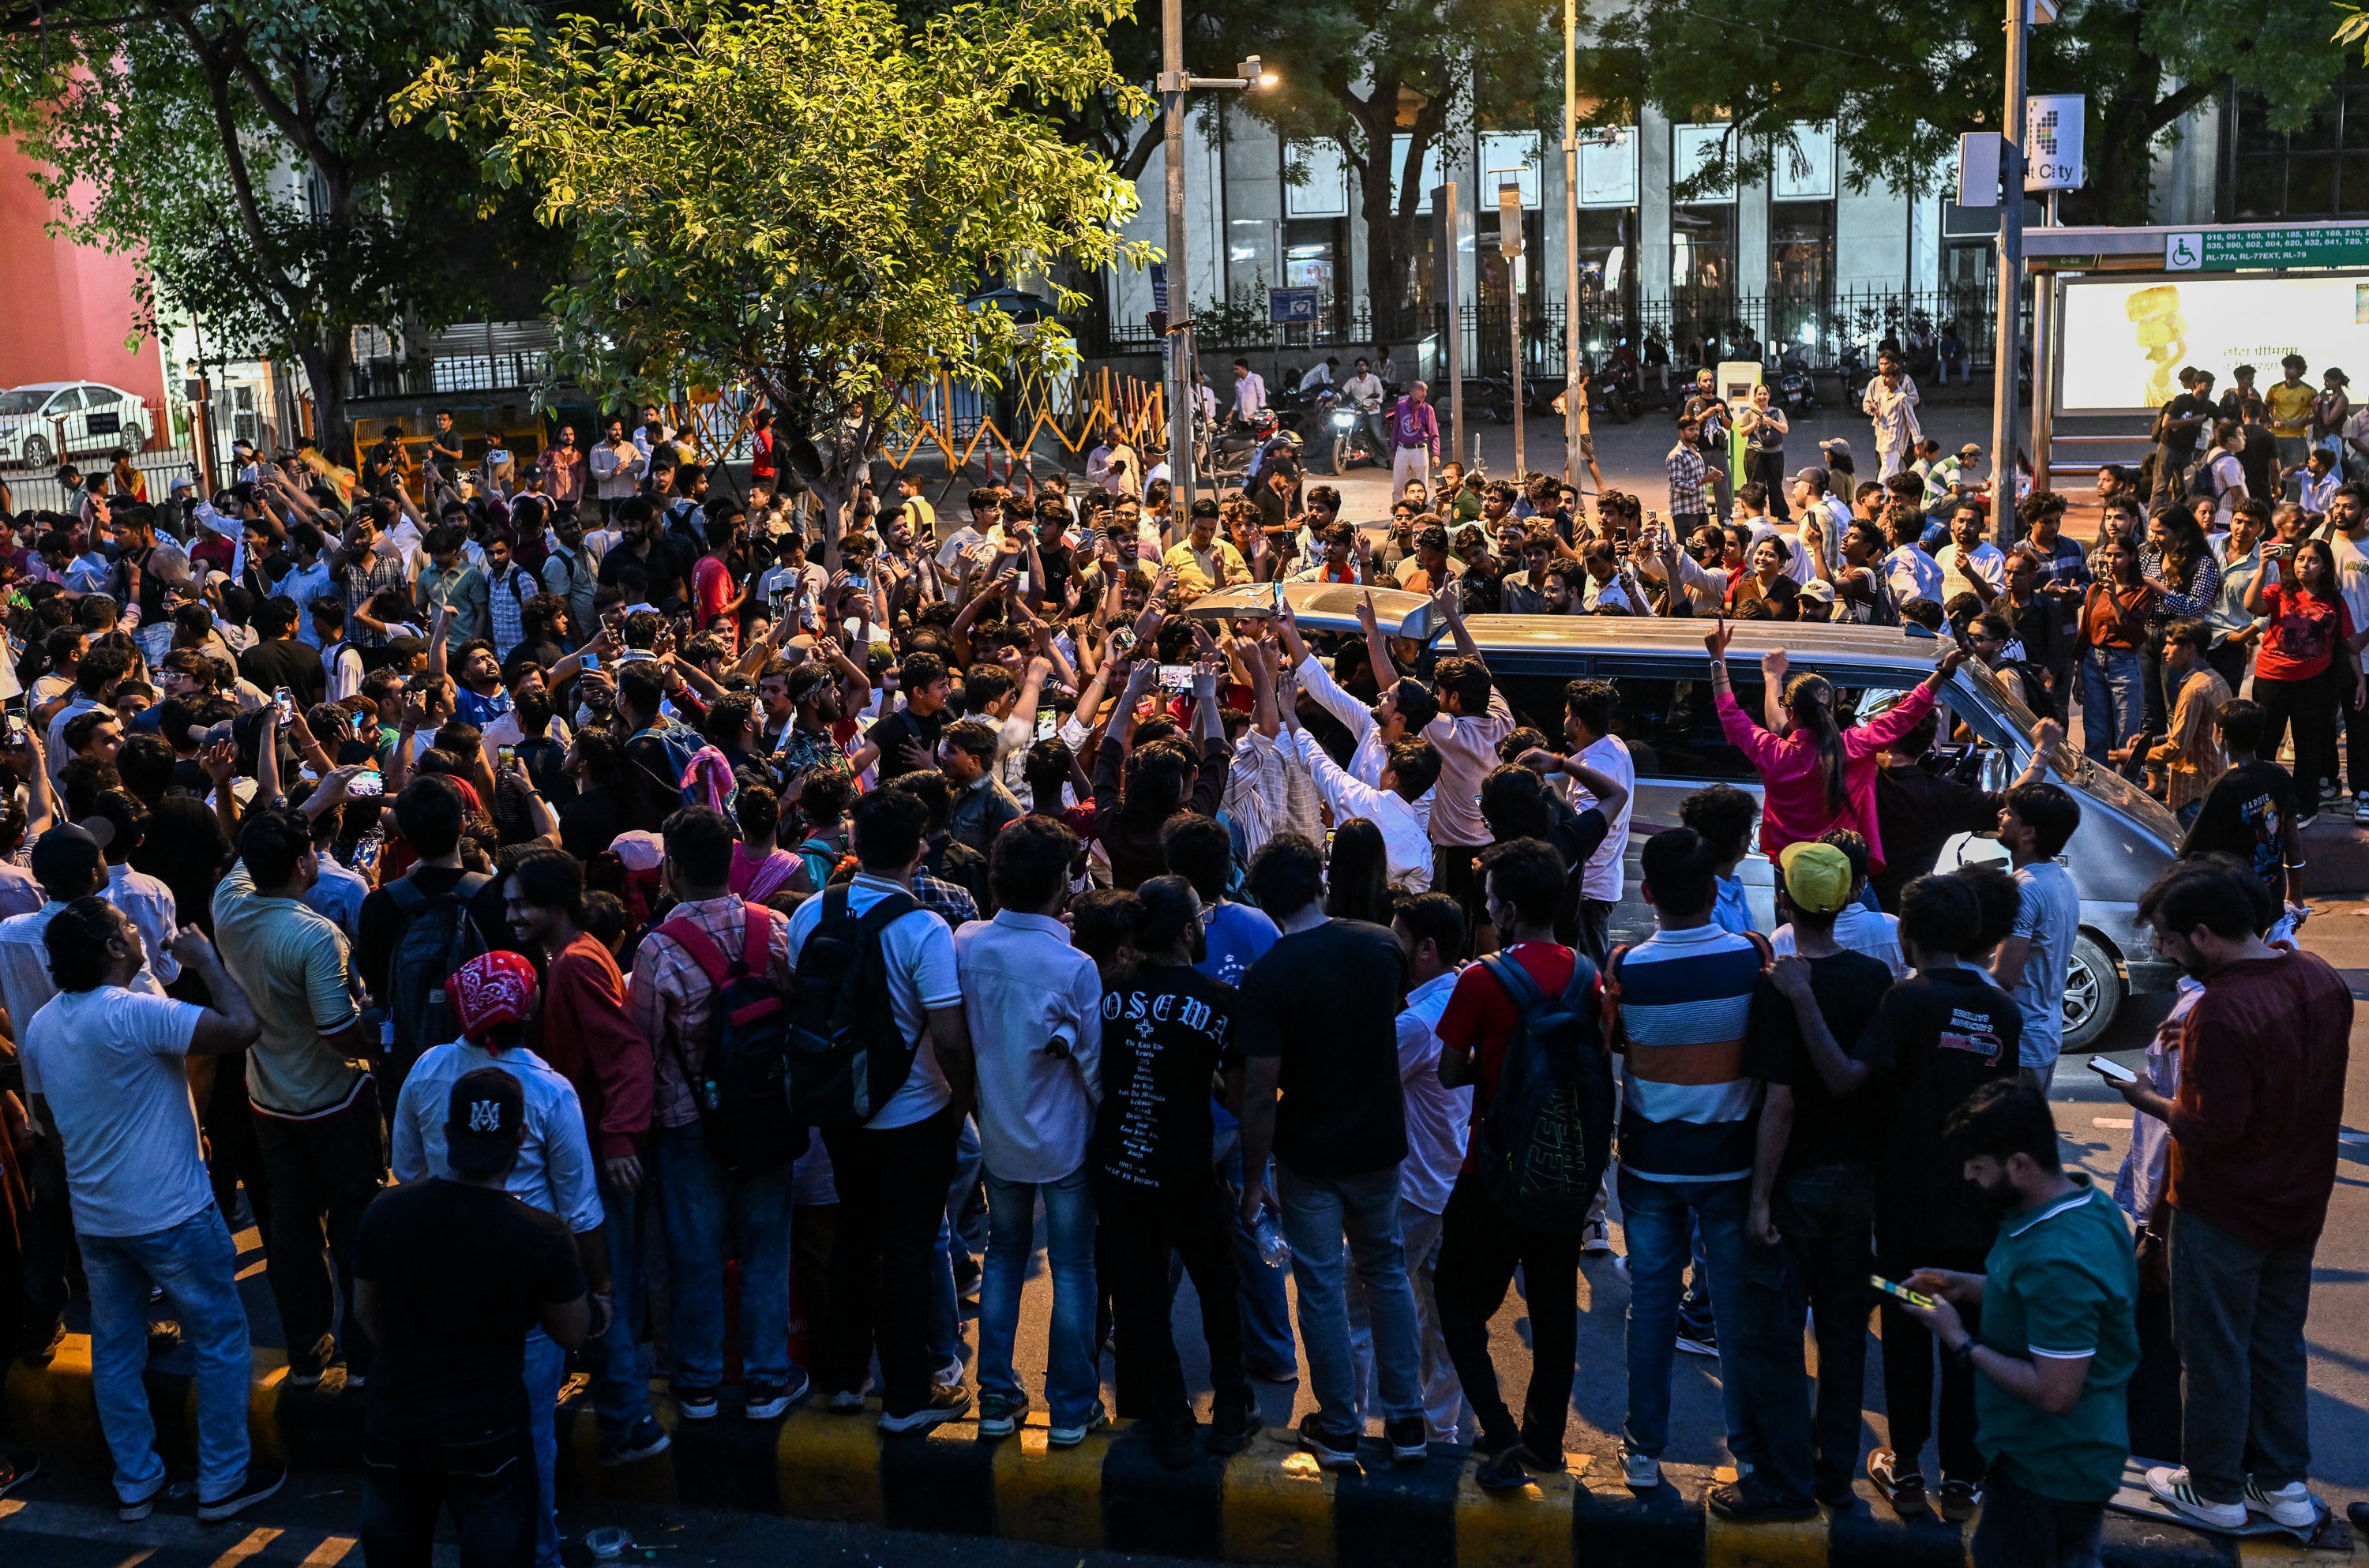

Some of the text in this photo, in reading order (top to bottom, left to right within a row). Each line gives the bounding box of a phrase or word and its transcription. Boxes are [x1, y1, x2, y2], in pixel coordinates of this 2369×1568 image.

[2040, 164, 2073, 182] City
[2239, 252, 2281, 261] RL-77EXT,
[1953, 1008, 1990, 1022] BATTERIES
